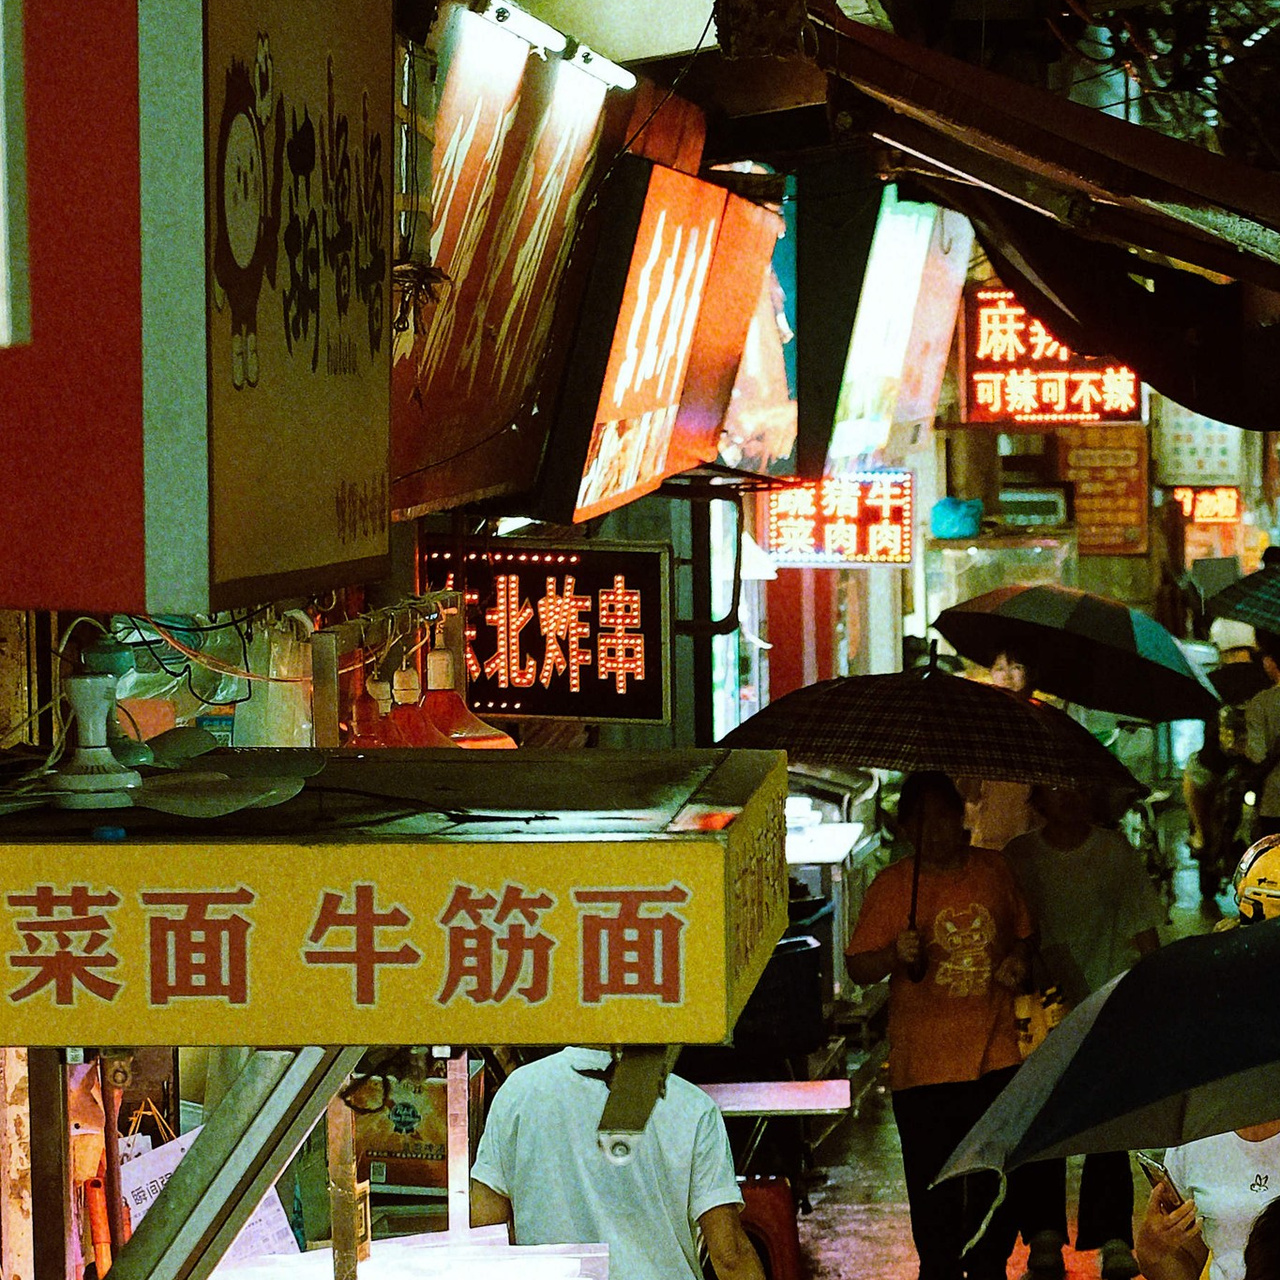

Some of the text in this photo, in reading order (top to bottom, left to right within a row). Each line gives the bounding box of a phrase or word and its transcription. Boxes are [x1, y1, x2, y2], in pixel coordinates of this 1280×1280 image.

[972, 365, 1136, 414] 可辣可不辣
[6, 884, 256, 1006] 菜面
[304, 882, 693, 1006] 牛筋面
